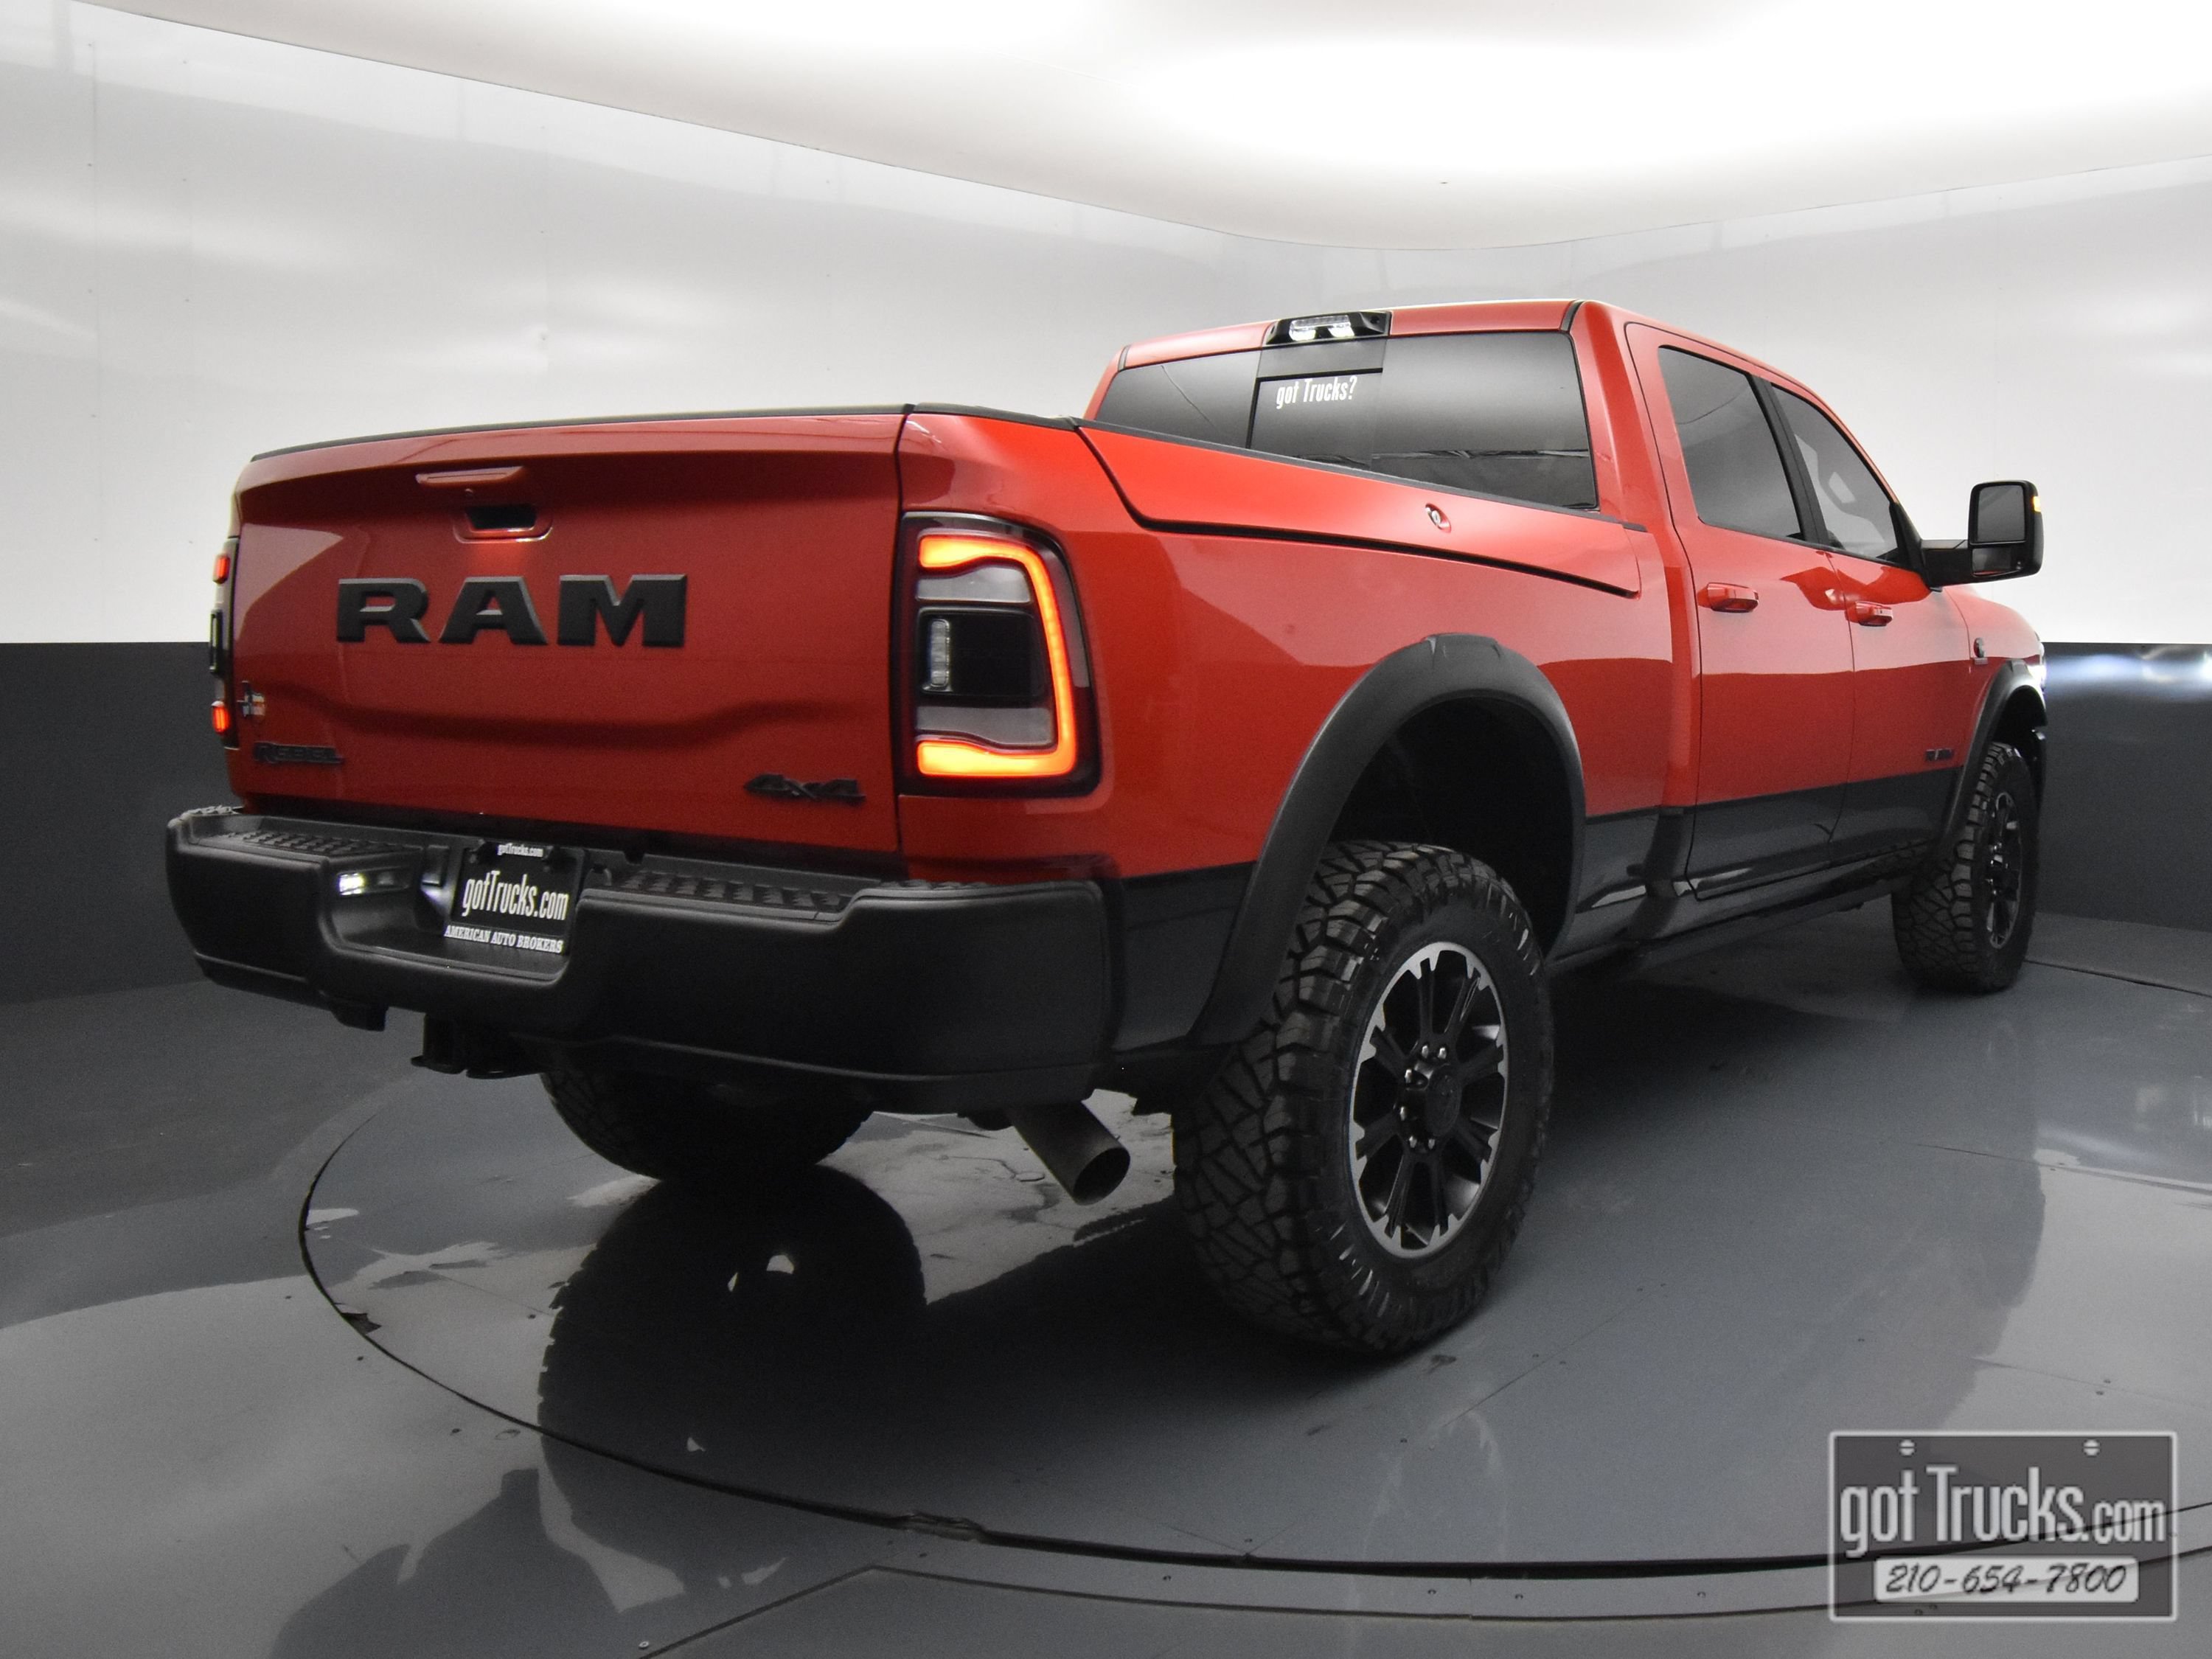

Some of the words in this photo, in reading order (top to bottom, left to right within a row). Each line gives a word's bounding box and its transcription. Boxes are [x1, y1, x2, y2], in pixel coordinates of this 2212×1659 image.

[1276, 380, 1299, 409] got
[1303, 375, 1357, 402] Trucks?
[336, 574, 689, 647] RAM
[497, 843, 543, 858] gotTrucks.com
[462, 870, 569, 920] gotTrucks.com
[444, 925, 491, 943] AMERICAN
[490, 932, 516, 947] AUTO
[516, 936, 564, 953] BROKERS
